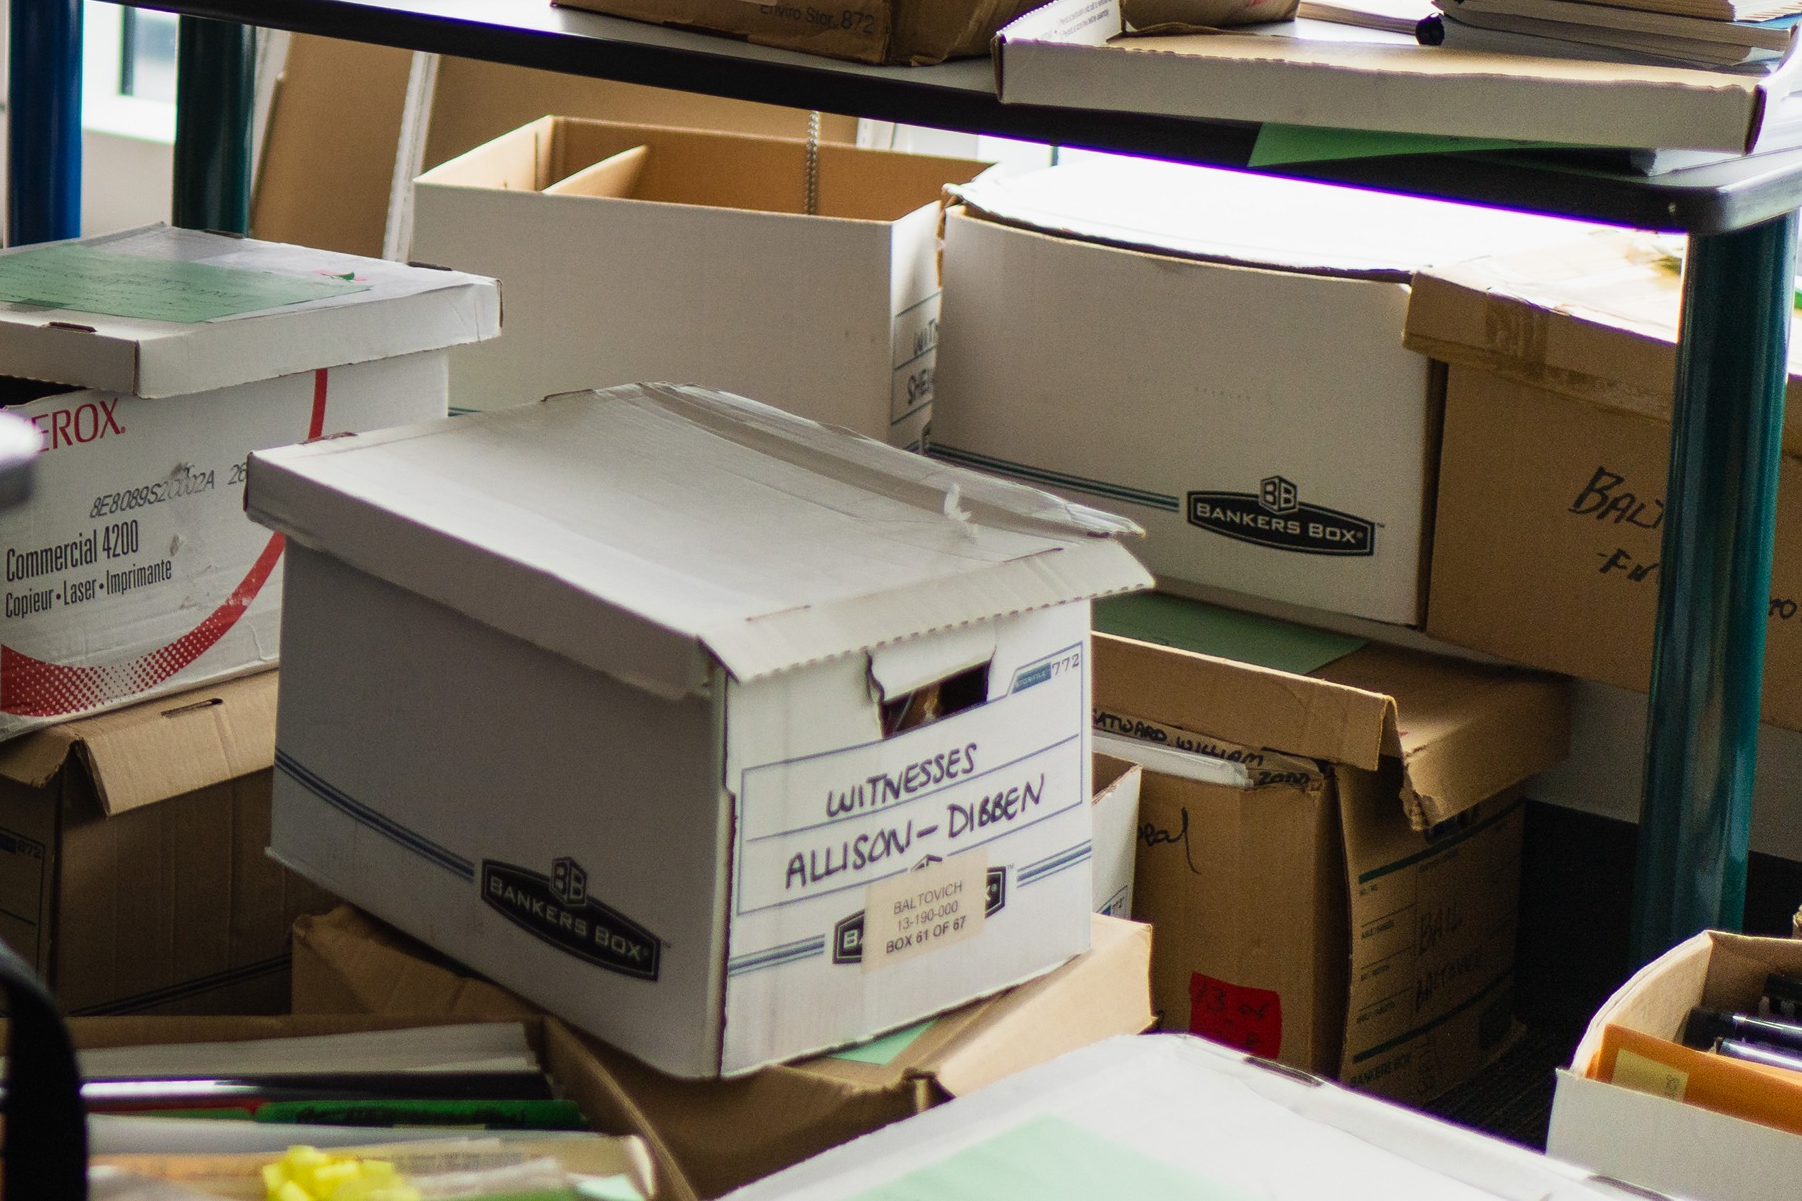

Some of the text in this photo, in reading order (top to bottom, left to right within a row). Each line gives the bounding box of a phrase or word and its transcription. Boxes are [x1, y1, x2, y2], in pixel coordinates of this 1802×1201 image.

[841, 10, 875, 35] 872
[31, 398, 121, 453] EROX
[1197, 503, 1355, 543] BANKERS BOX
[6, 519, 139, 582] Commercial 4200
[1052, 653, 1079, 676] 772
[827, 742, 978, 818] WITNESSES
[489, 875, 642, 960] BANKERS BOX
[893, 881, 963, 915] BALTOVICH
[897, 901, 958, 931] 13-190-000
[885, 916, 967, 955] BOX 61 OF 67
